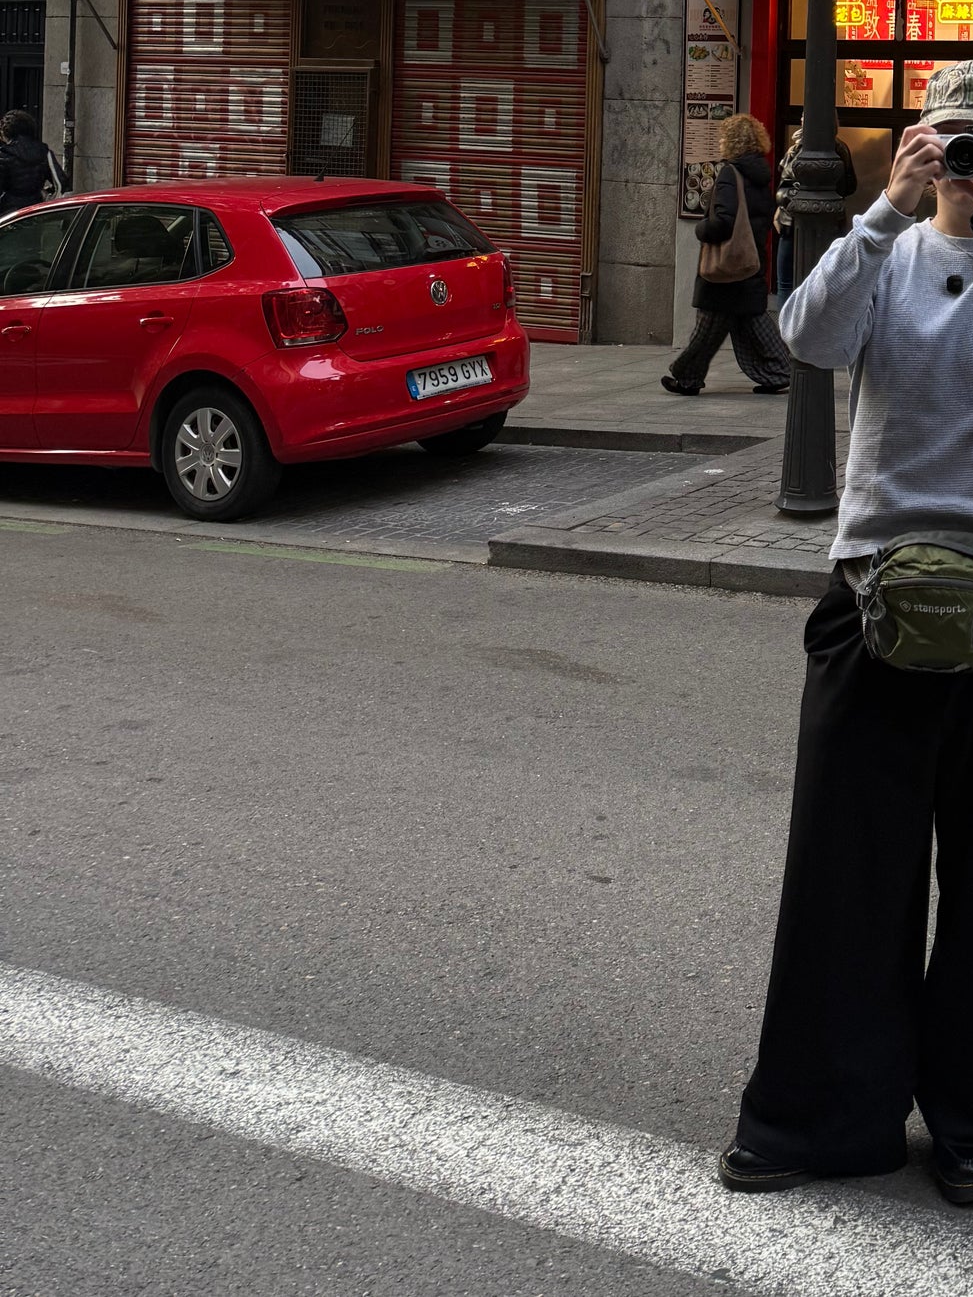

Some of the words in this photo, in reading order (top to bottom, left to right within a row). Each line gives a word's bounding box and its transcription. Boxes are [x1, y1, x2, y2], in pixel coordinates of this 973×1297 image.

[355, 325, 385, 336] POLO
[418, 365, 459, 391] 7959
[460, 359, 489, 381] GYX
[913, 603, 962, 616] stansport
